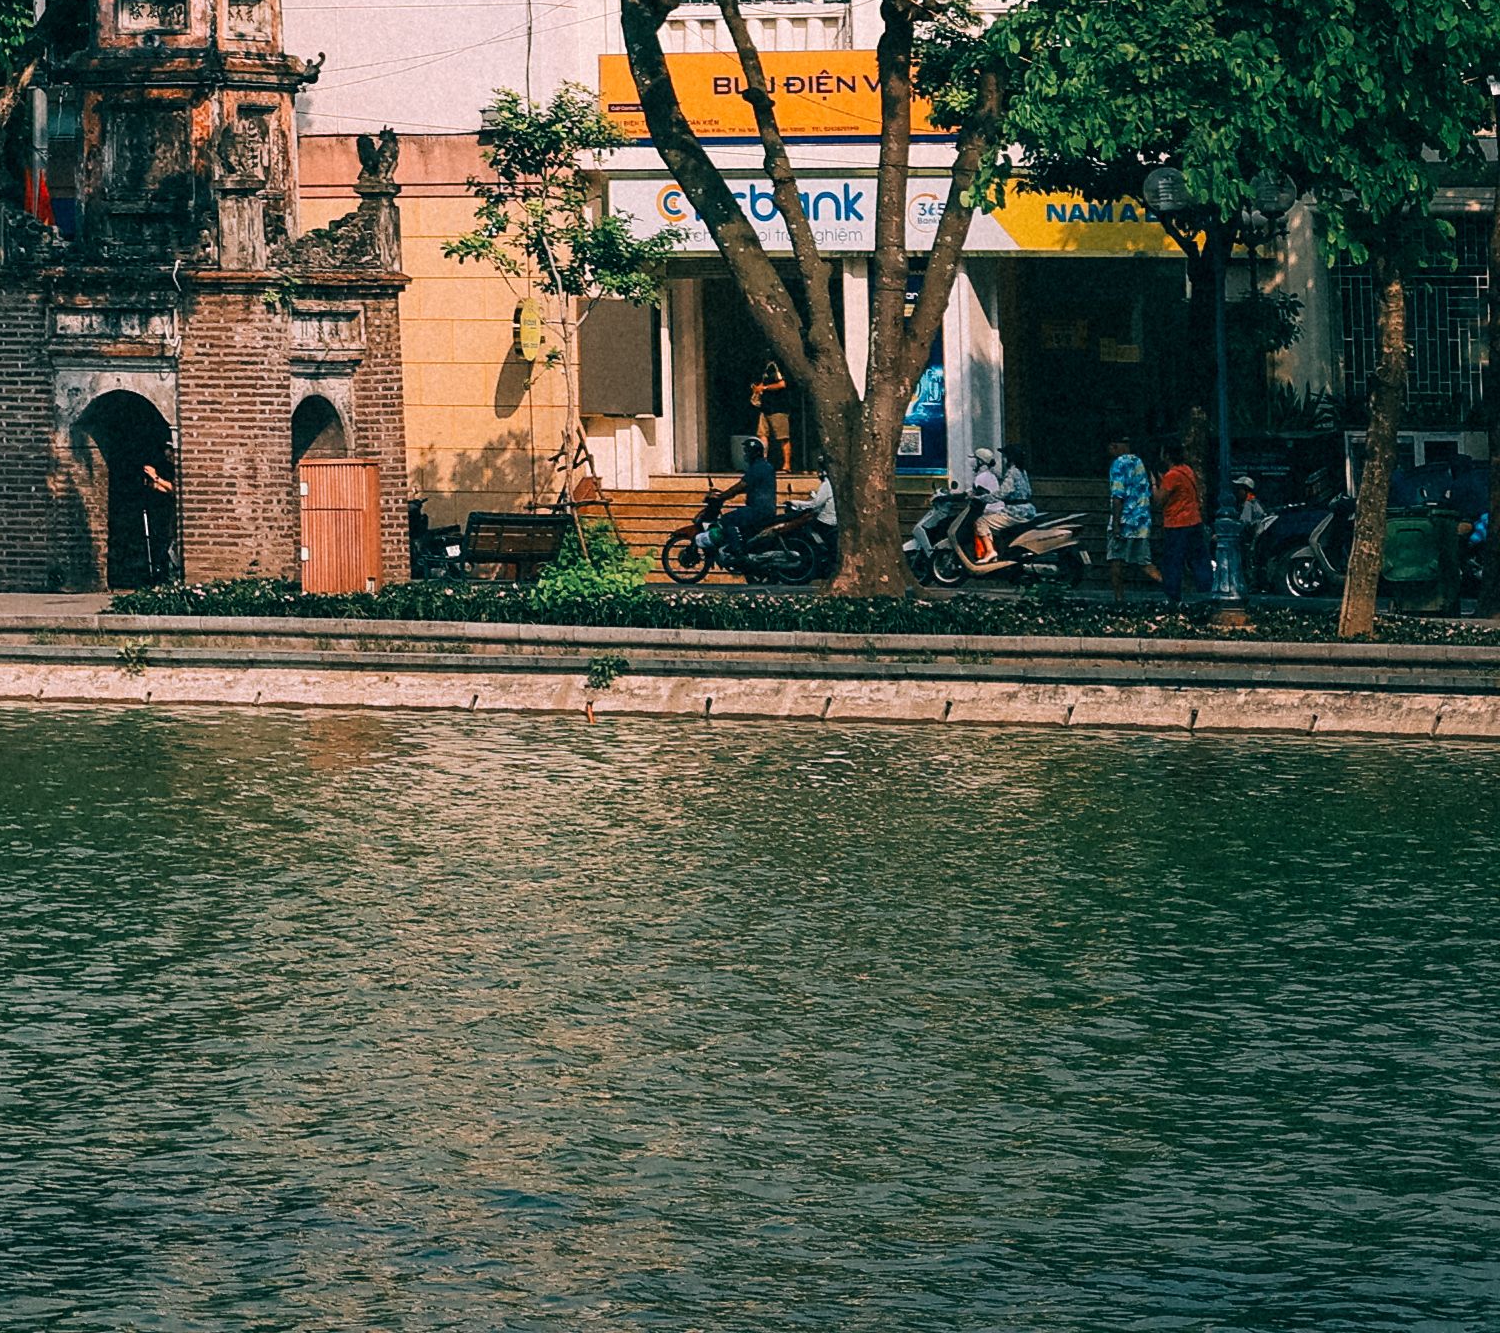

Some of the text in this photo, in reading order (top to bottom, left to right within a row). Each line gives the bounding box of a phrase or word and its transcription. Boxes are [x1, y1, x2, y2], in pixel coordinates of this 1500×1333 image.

[782, 69, 857, 101] ĐIỆN
[1046, 203, 1113, 223] NAM
[813, 228, 864, 246] ghiệm
